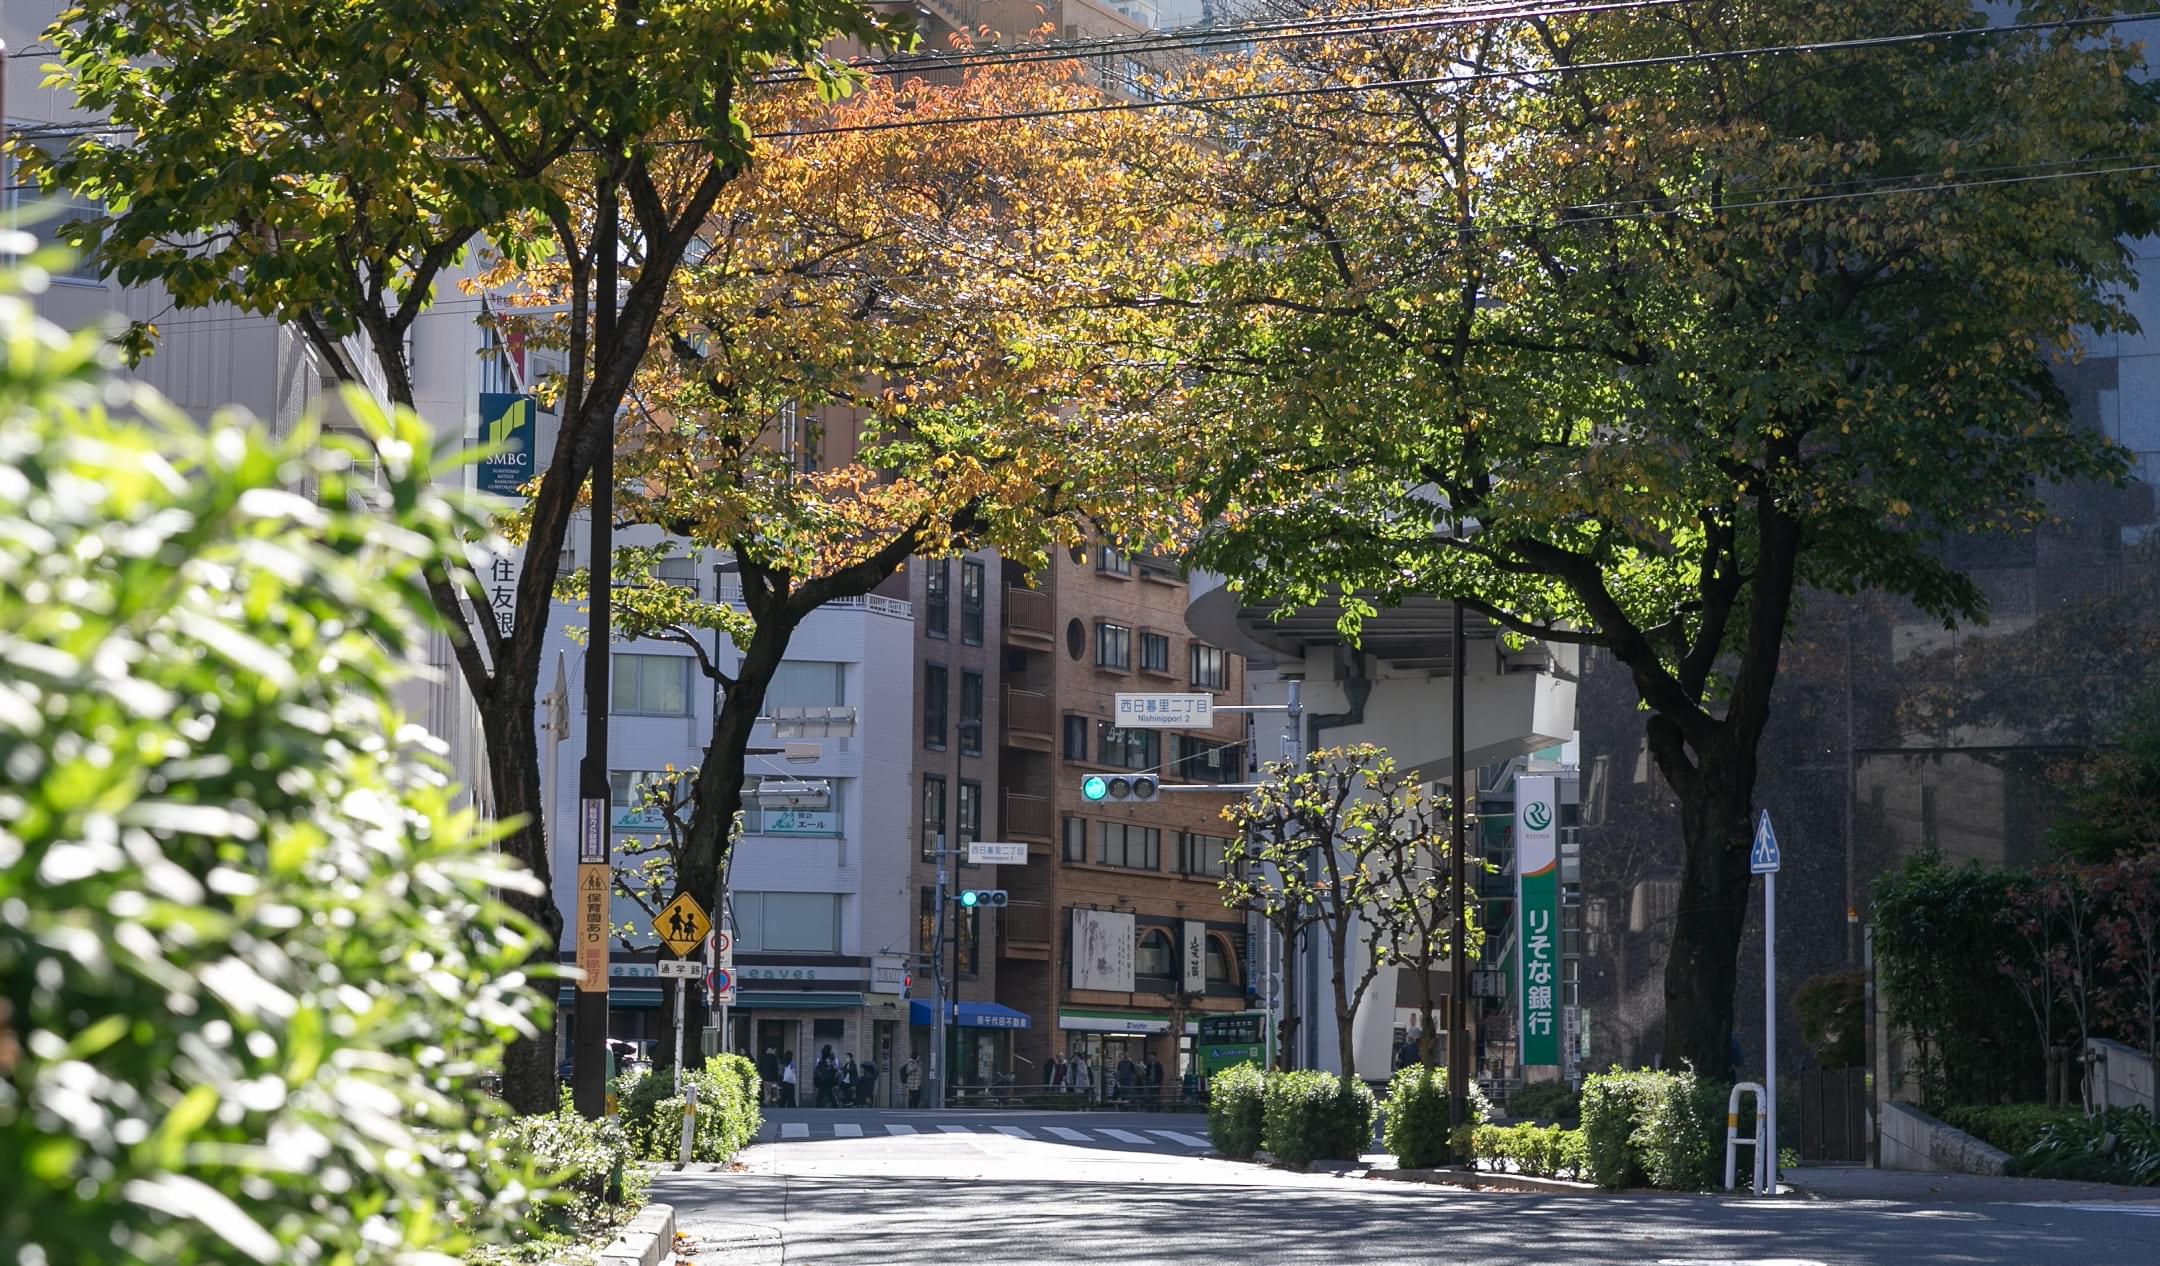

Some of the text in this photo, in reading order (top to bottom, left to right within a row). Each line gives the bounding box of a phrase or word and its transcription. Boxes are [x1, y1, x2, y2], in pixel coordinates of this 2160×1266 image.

[486, 453, 527, 466] SMBC
[1120, 699, 1207, 713] 西日暮里二丁目
[1137, 714, 1191, 724] Nishinippori 2
[797, 820, 826, 830] エール
[587, 893, 602, 943] 保育園あり
[661, 963, 701, 975] 通学路
[1528, 910, 1553, 1035] りそな銀行
